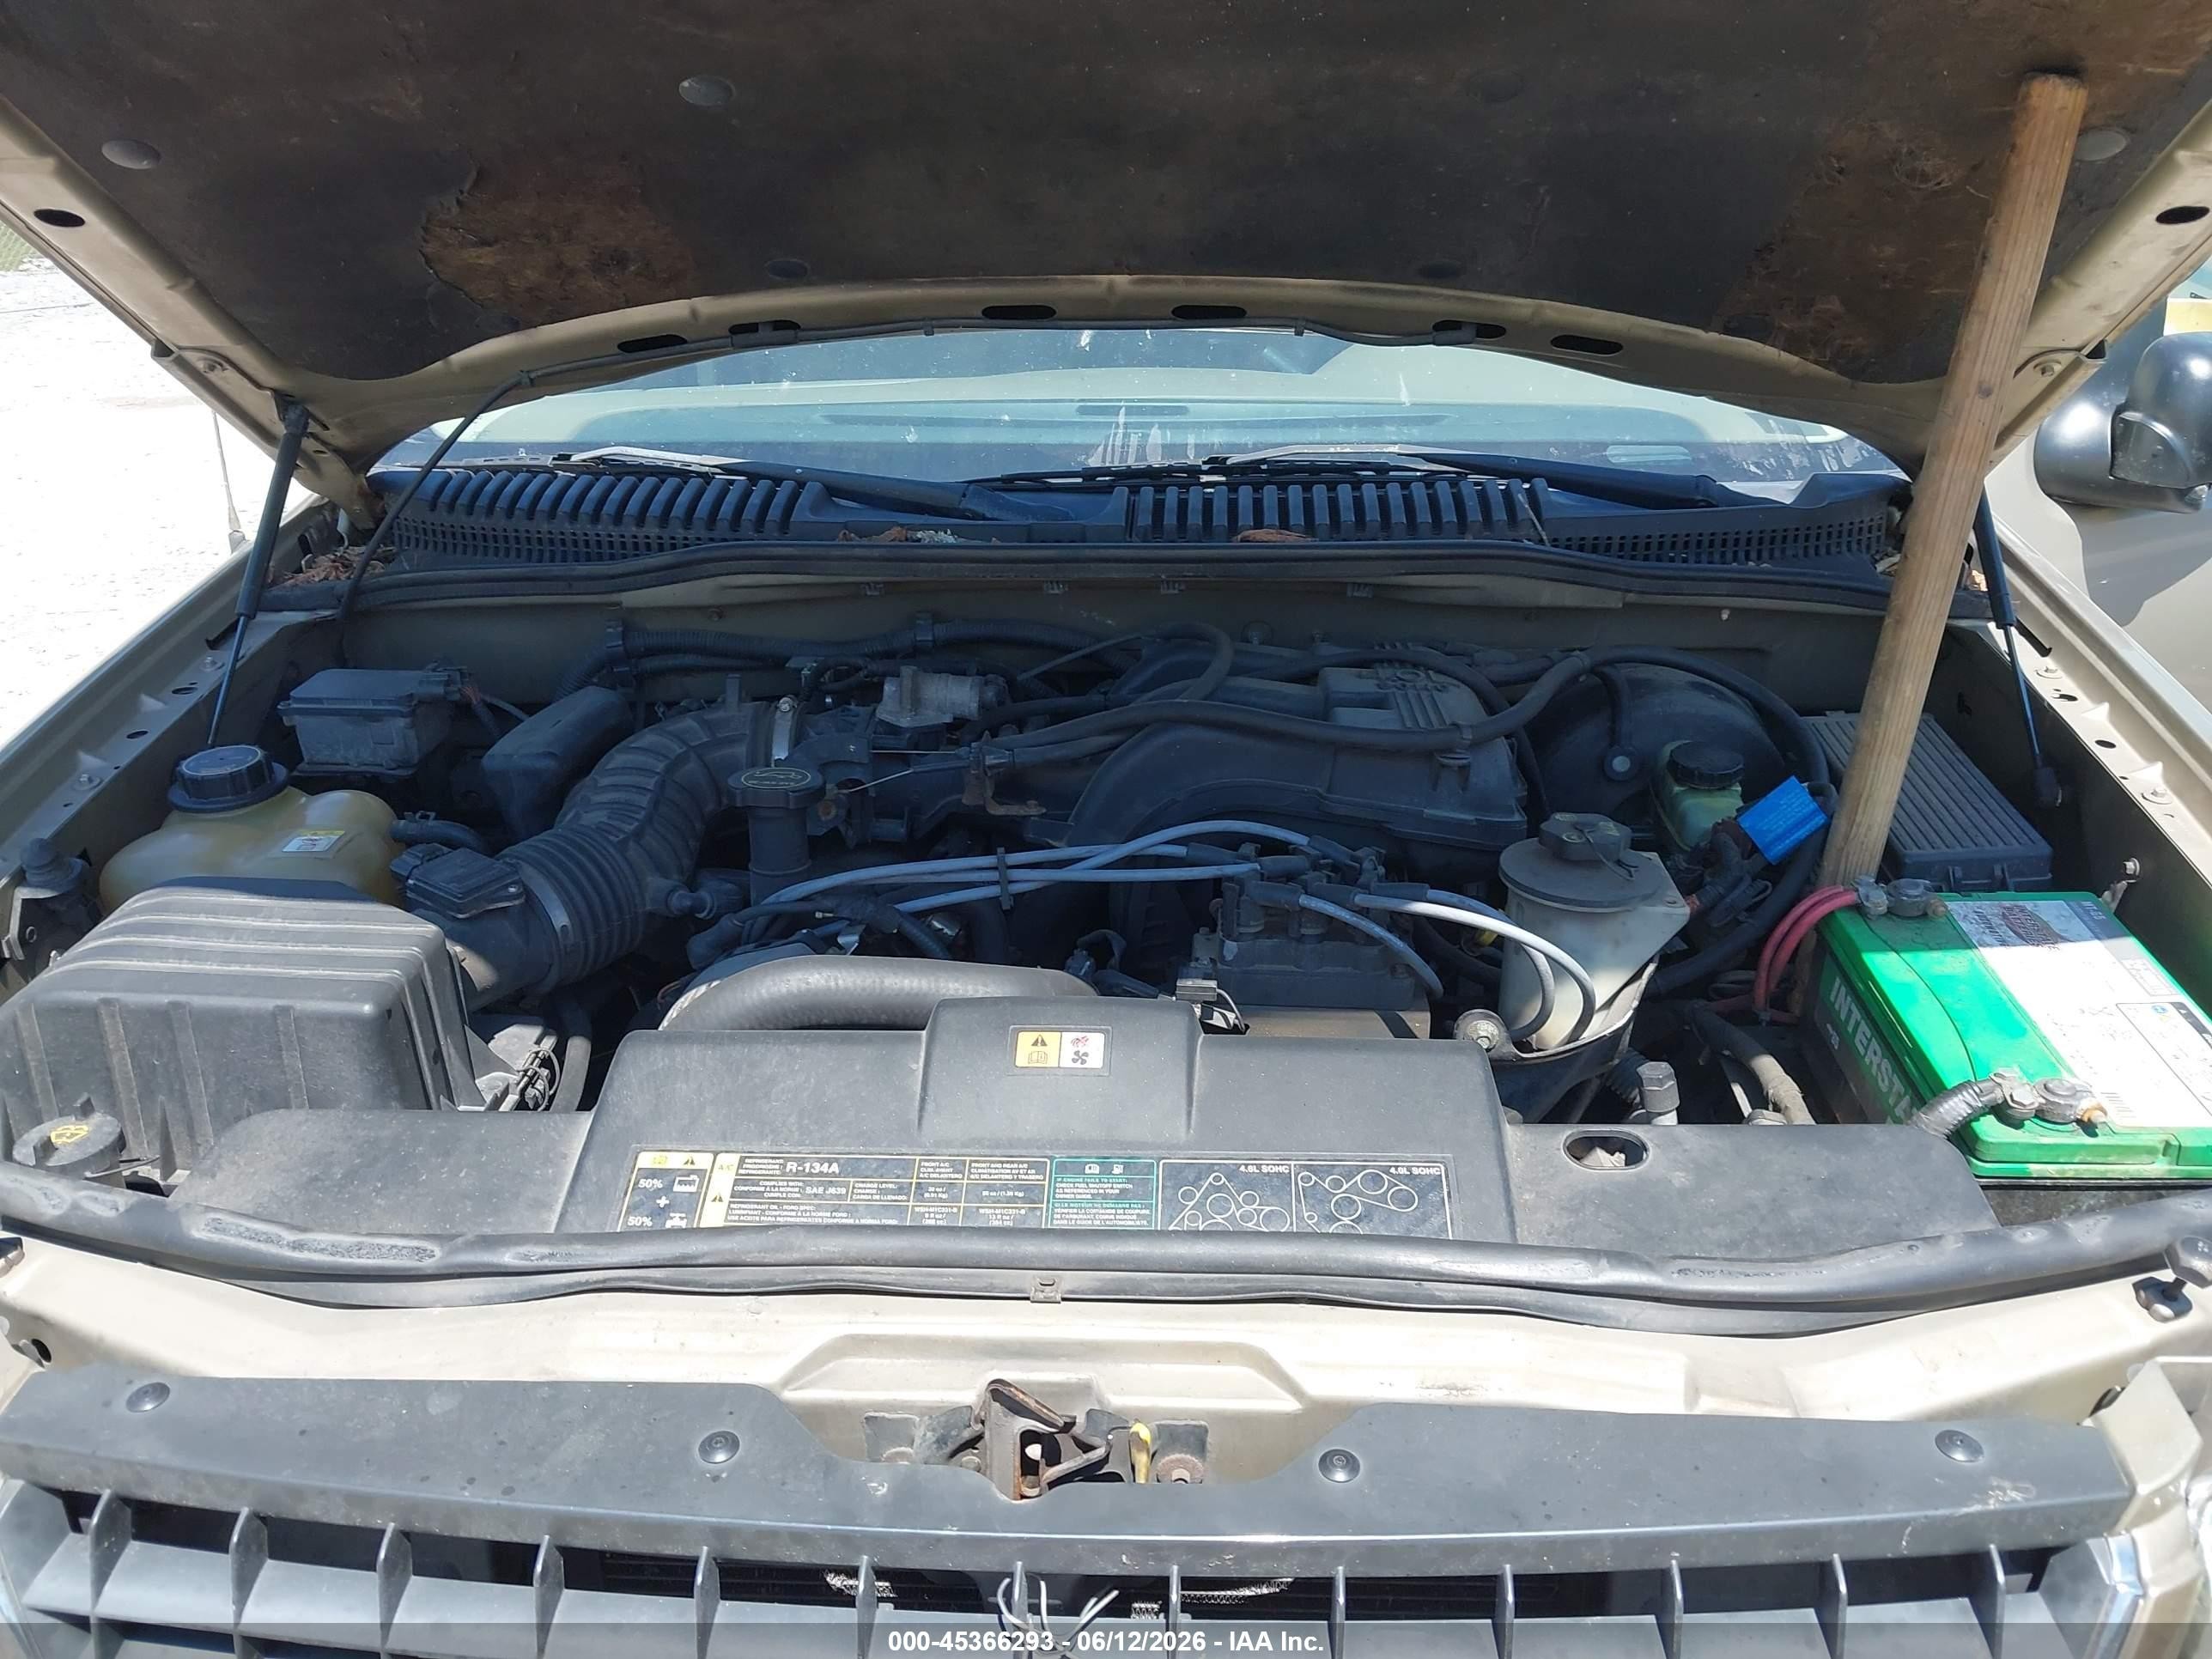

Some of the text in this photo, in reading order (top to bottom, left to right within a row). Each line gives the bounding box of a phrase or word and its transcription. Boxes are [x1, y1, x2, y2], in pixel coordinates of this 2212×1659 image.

[786, 1162, 839, 1174] R-134A
[638, 1178, 663, 1188] 50%
[628, 1216, 653, 1226] 50%
